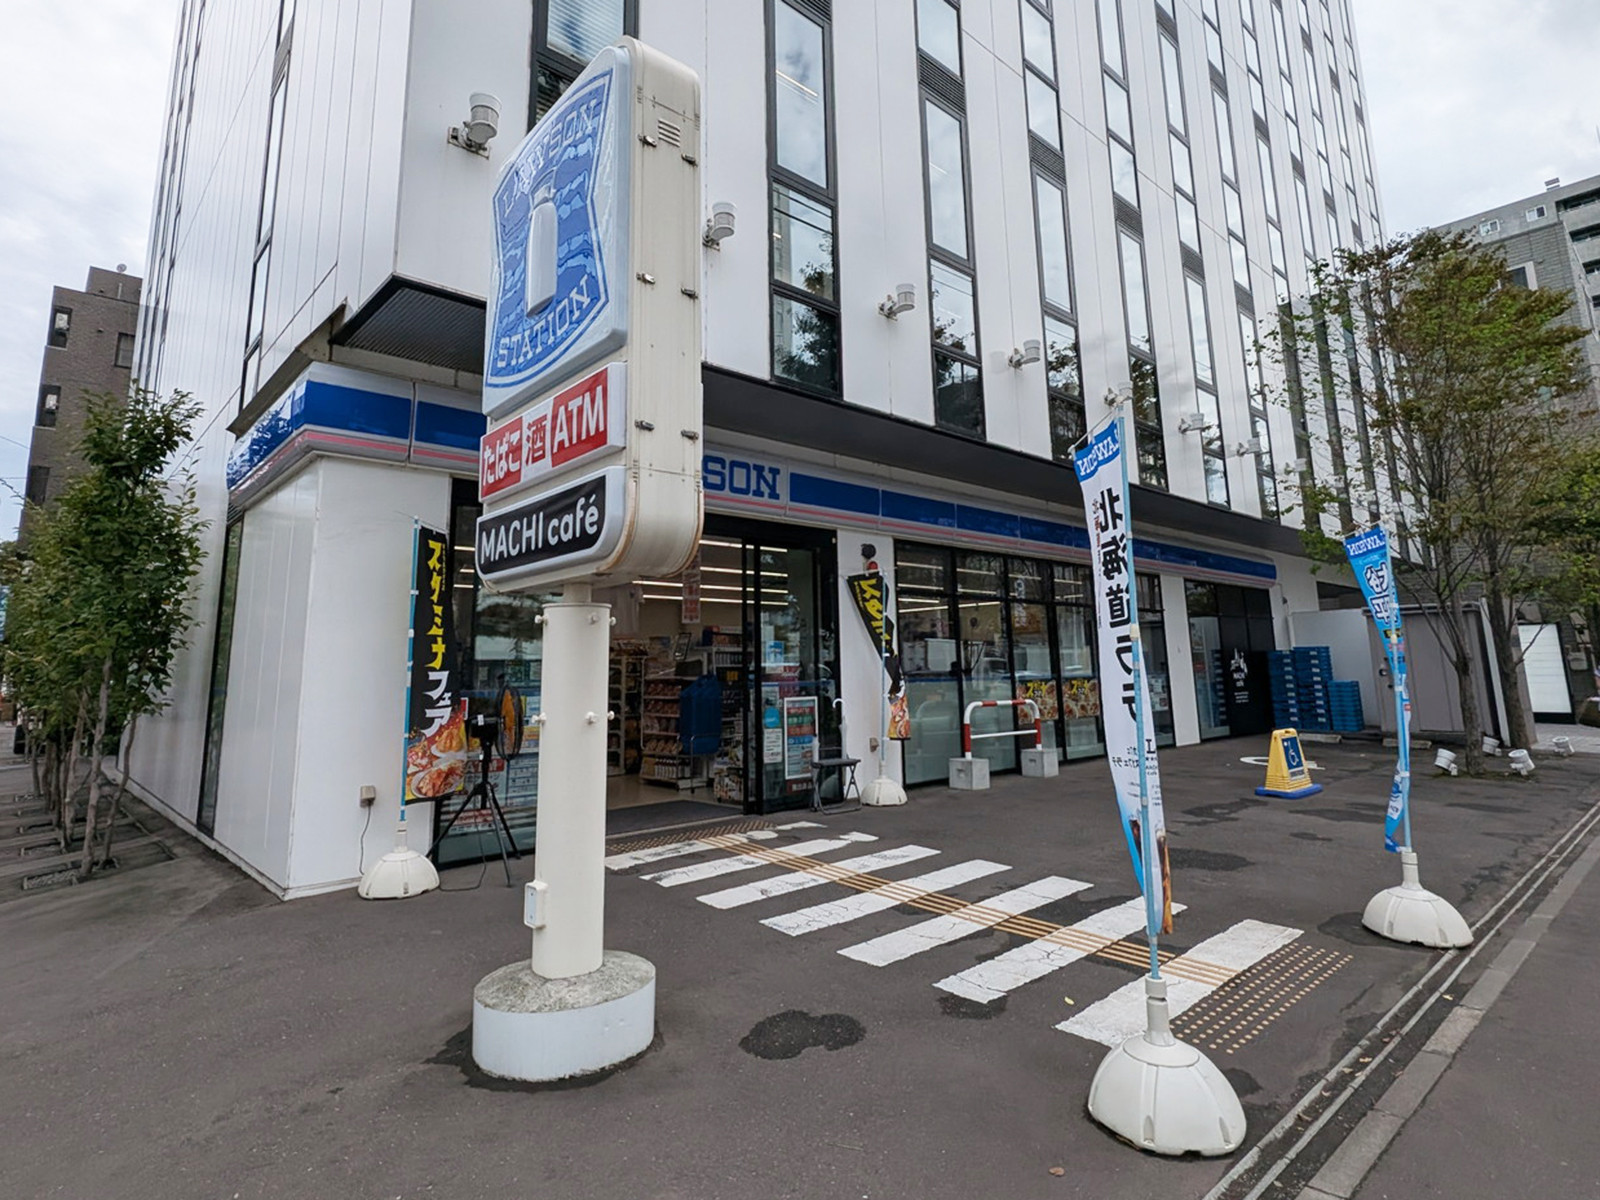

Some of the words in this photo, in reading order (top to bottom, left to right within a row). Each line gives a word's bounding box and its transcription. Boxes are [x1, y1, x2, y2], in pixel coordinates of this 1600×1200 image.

[502, 98, 601, 217] LAWSON
[497, 273, 591, 367] STATION
[482, 430, 522, 487] たばこ
[525, 414, 548, 465] 酒
[552, 384, 605, 454] ATM
[703, 455, 781, 501] SON
[480, 511, 544, 565] MACHI
[547, 493, 600, 546] café
[421, 538, 453, 738] スタミナフェア
